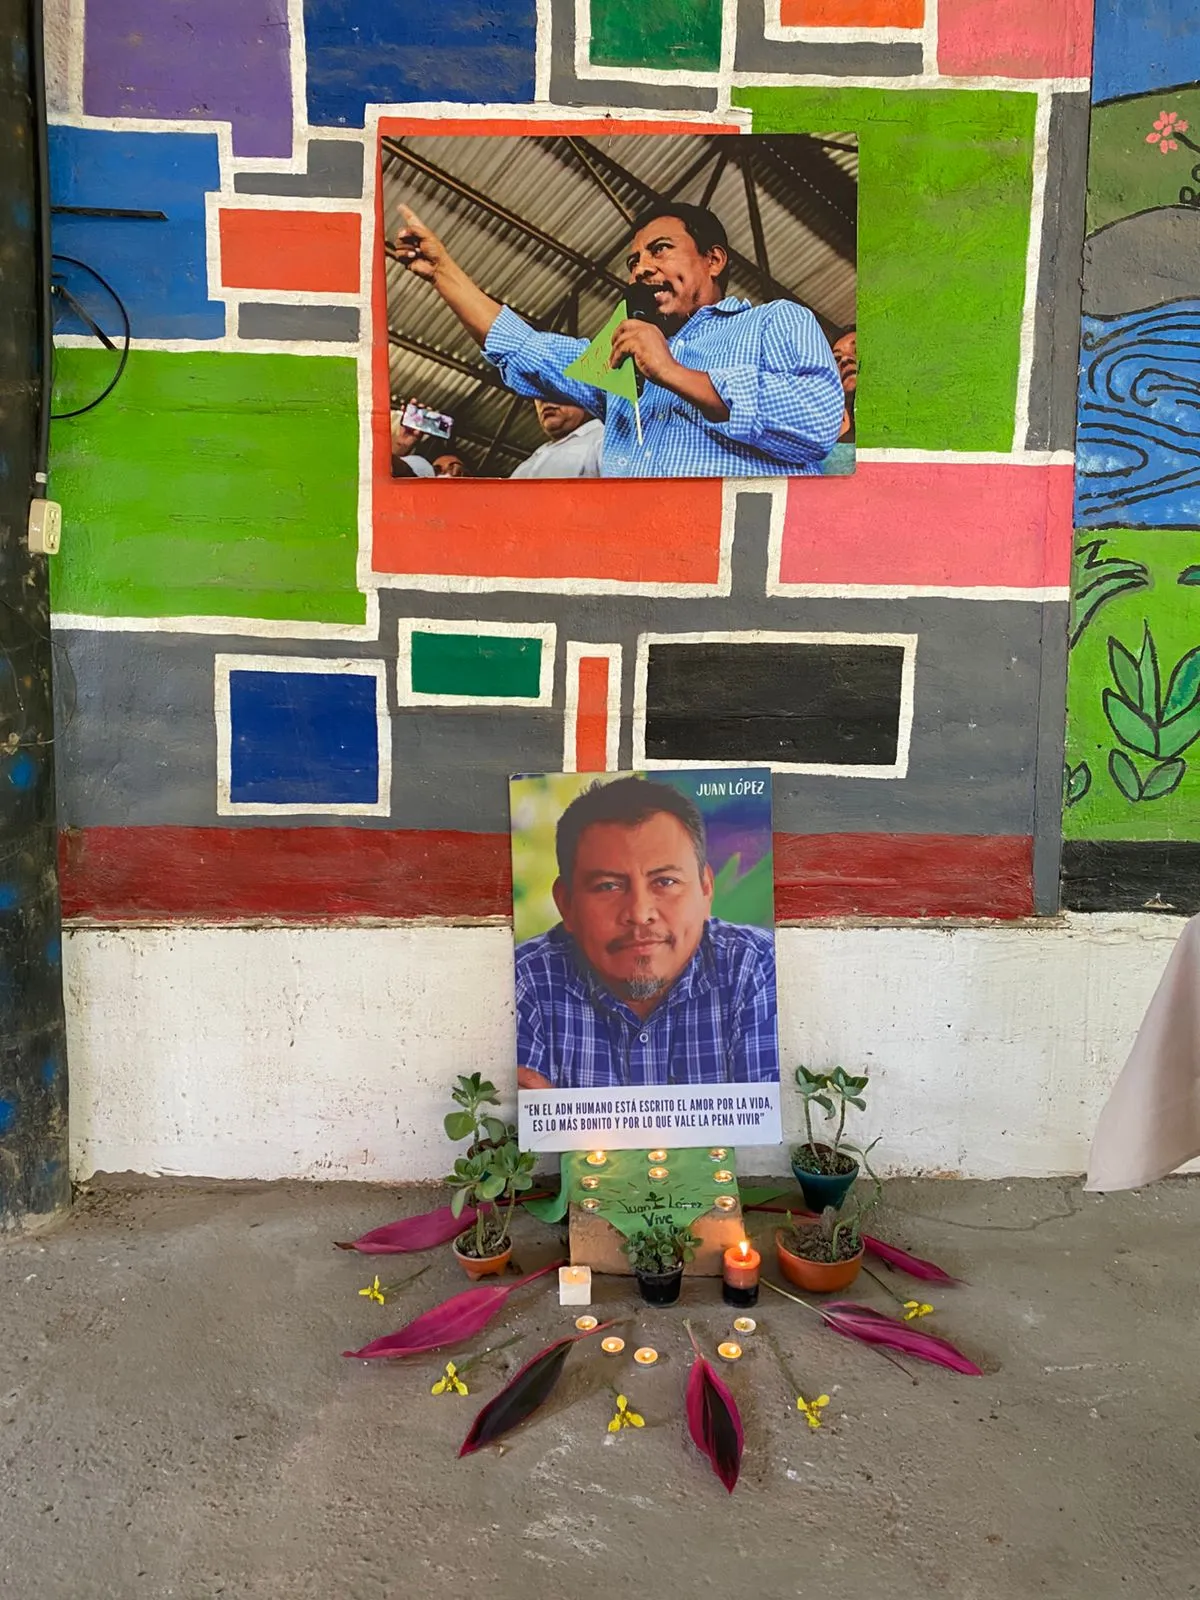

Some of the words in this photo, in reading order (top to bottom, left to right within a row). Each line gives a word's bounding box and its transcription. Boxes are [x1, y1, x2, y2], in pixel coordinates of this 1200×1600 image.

[696, 783, 726, 796] JUAN
[729, 778, 765, 795] LÓPEZ
[543, 1103, 552, 1115] EL
[555, 1103, 573, 1115] ADN
[576, 1102, 613, 1114] HUMANO
[615, 1099, 637, 1113] ESTÁ
[640, 1099, 675, 1112] ESCRITO
[677, 1099, 687, 1111] EL
[690, 1099, 714, 1110] AMOR
[717, 1098, 734, 1110] POR
[736, 1097, 747, 1109] LA
[749, 1097, 773, 1110] VIDA,
[533, 1120, 543, 1132] ES
[546, 1119, 556, 1131] LO
[560, 1117, 578, 1131] MÁS
[580, 1117, 612, 1130] BONITO
[615, 1117, 620, 1129] Y
[623, 1116, 640, 1129] POR
[642, 1116, 653, 1128] LO
[656, 1115, 672, 1128] QUE
[675, 1114, 696, 1127] VALE
[699, 1114, 709, 1127] LA
[712, 1113, 734, 1126] PENA
[616, 1199, 652, 1214] Juan
[641, 1212, 674, 1227] Vive
